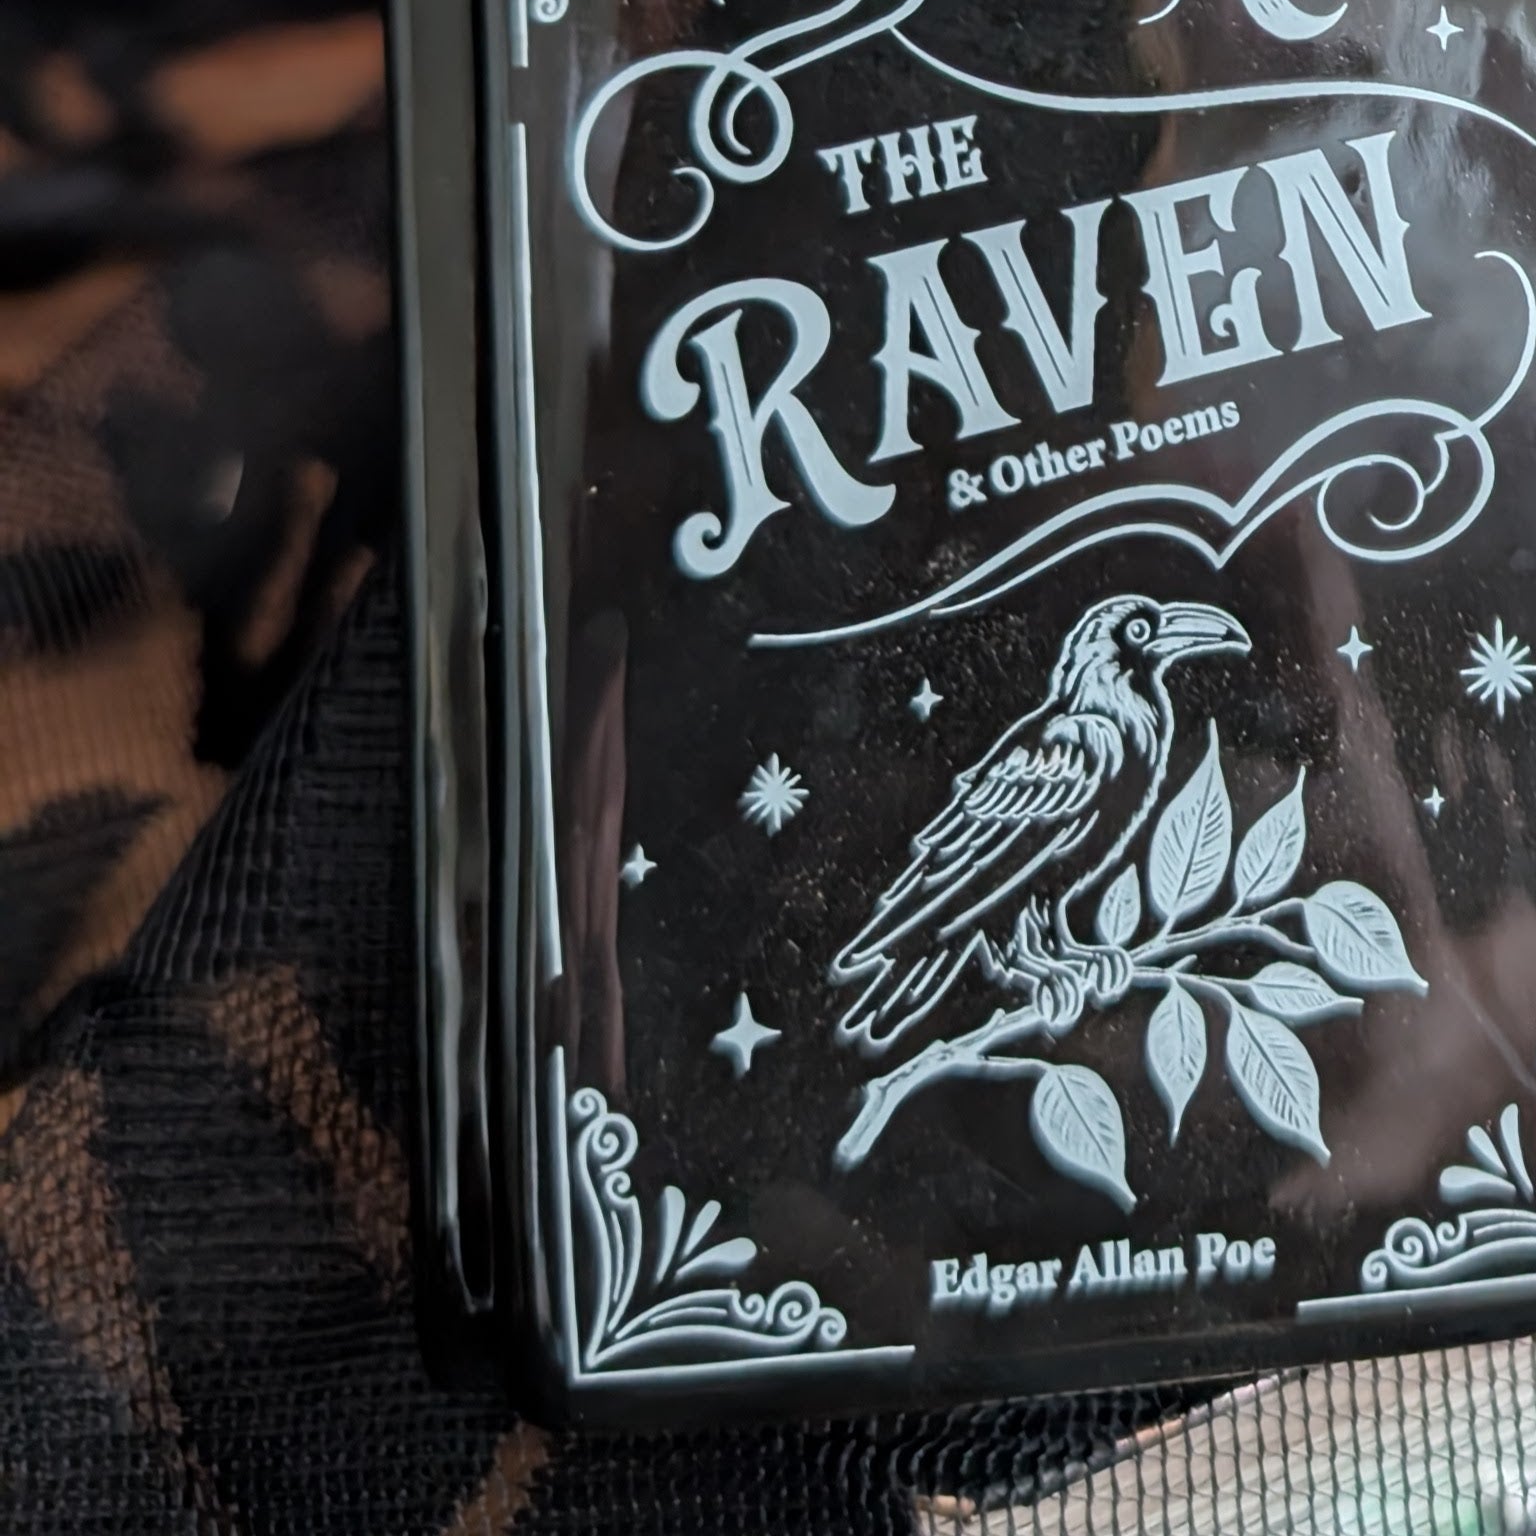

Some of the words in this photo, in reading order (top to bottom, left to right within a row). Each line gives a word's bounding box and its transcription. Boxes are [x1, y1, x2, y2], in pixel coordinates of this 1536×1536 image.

[818, 114, 988, 215] THE
[641, 130, 1433, 579] RAVEN
[949, 468, 988, 509] &
[989, 440, 1107, 495] Other
[1109, 401, 1240, 461] Poems
[930, 1251, 1062, 1306] Edgar
[1068, 1237, 1188, 1288] Allan
[1196, 1232, 1277, 1274] Poe
